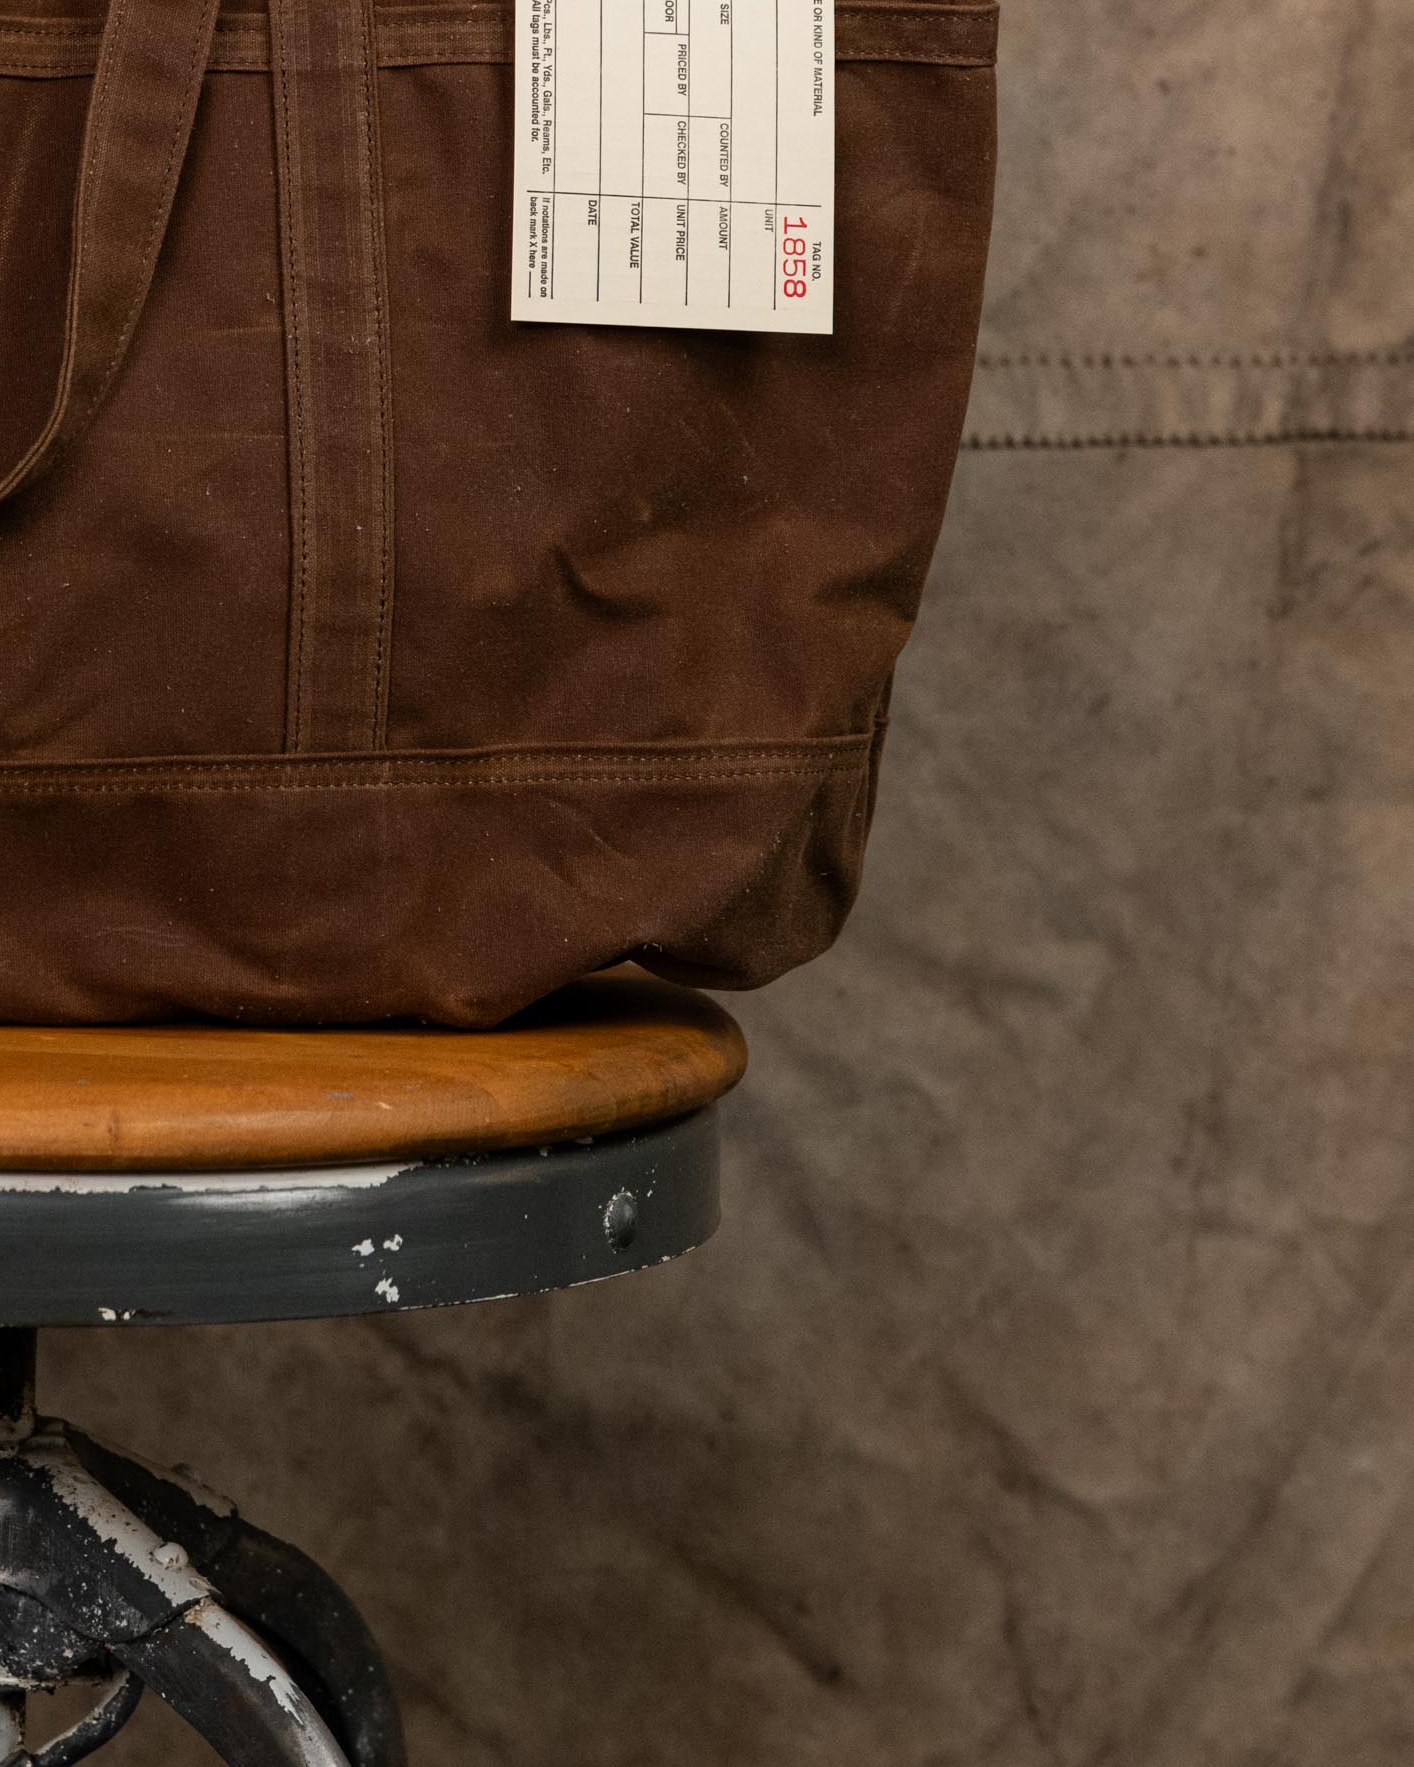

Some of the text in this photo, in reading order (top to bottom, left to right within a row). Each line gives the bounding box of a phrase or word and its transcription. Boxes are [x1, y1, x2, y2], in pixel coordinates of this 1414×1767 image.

[532, 0, 540, 12] All
[720, 3, 729, 25] SIZE
[813, 7, 822, 22] OR
[530, 14, 540, 34] tags
[532, 37, 540, 59] must
[813, 25, 822, 48] KIND
[532, 62, 540, 74] be
[814, 51, 822, 65] OF
[677, 44, 687, 96] PRICED BY
[531, 76, 540, 125] accounted
[813, 67, 822, 116] MATERIAL
[531, 127, 540, 142] for.
[541, 119, 551, 154] Reams,
[677, 120, 686, 185] CHECKED BY
[720, 123, 728, 187] COUNTED BY
[542, 157, 551, 174] Etc.
[530, 197, 538, 216] back
[588, 200, 597, 226] DATE
[529, 218, 537, 239] mark
[541, 205, 549, 244] notations
[718, 206, 727, 250] AMOUNT
[765, 209, 773, 232] UNIT
[630, 202, 640, 268] TOTAL VALUE
[676, 205, 685, 261] UNIT PRICE
[529, 250, 537, 268] here
[783, 216, 808, 298] 1858
[812, 242, 821, 281] TAG NO.
[541, 262, 549, 284] made
[540, 287, 548, 298] on
